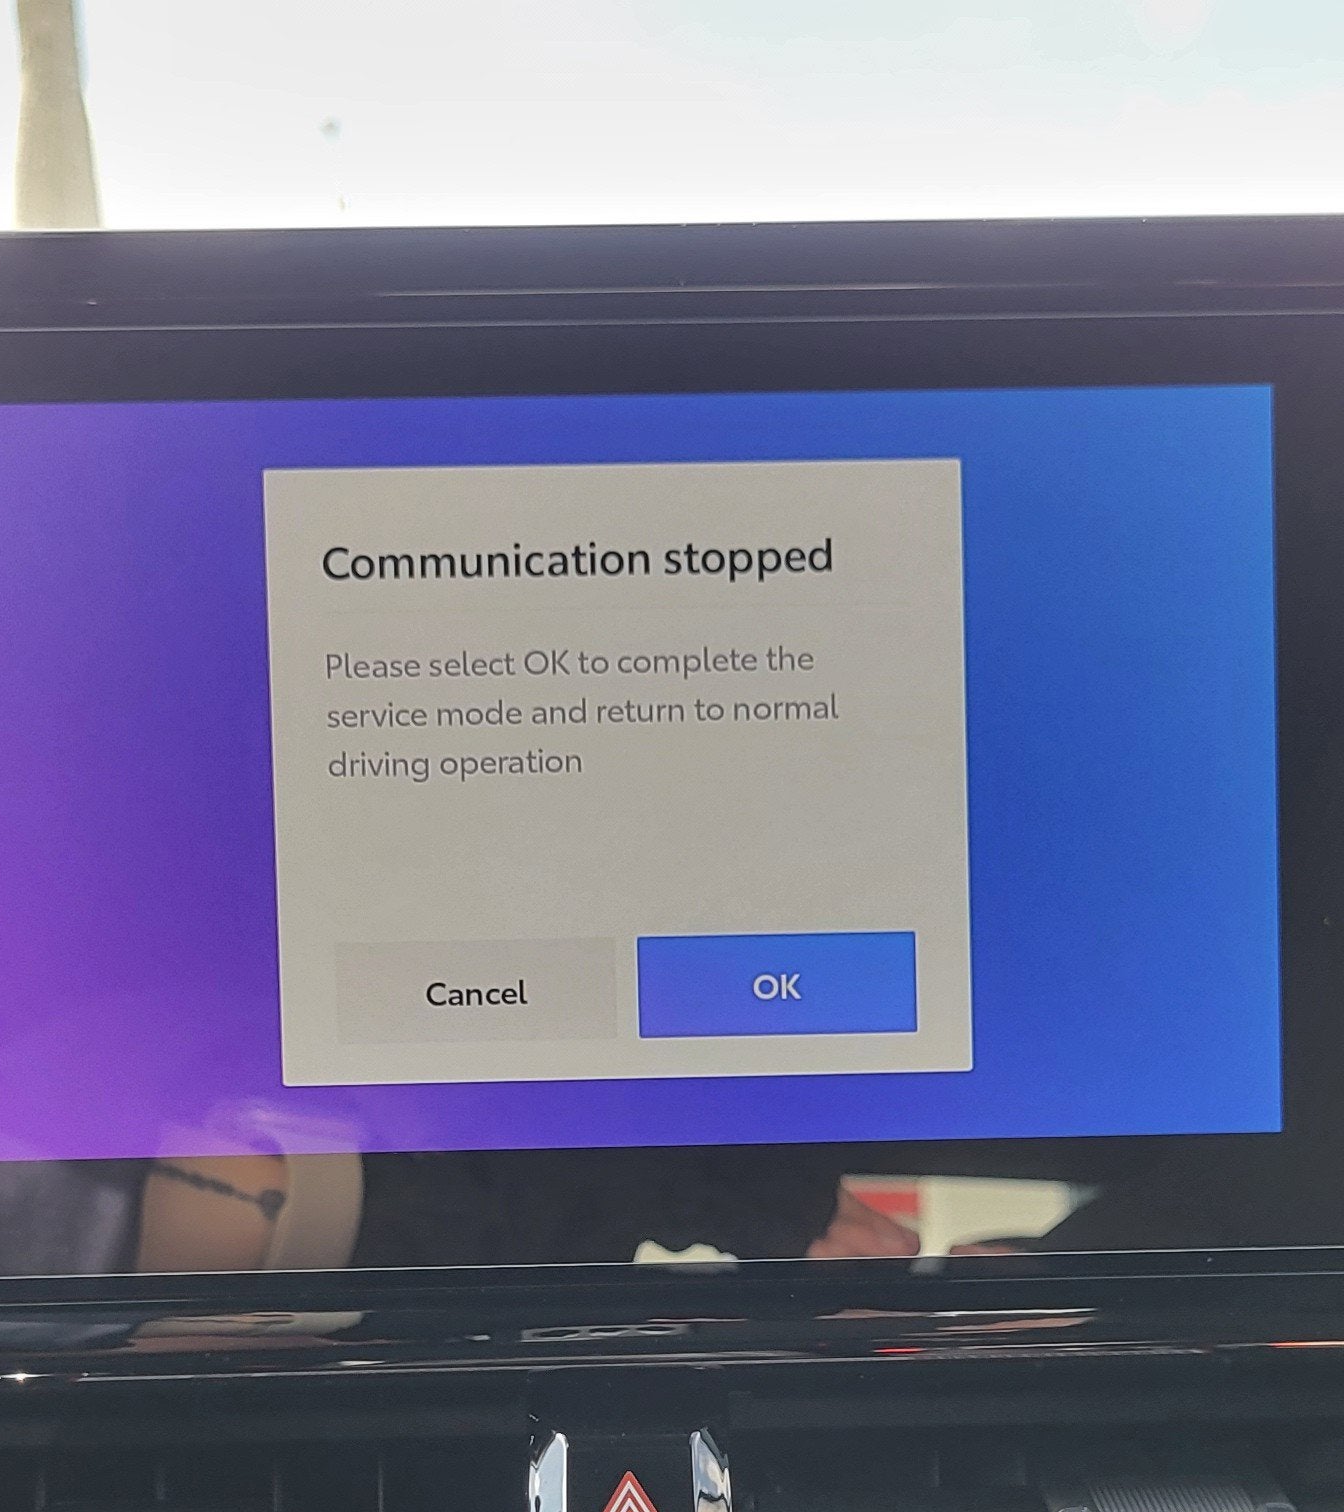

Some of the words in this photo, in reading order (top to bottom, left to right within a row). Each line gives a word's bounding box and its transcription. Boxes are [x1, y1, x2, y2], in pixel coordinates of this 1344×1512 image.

[321, 543, 651, 581] Communication
[663, 538, 833, 583] stopped
[326, 653, 421, 679] Please
[429, 650, 515, 677] select
[523, 649, 571, 676] OK
[578, 652, 610, 675] to
[617, 647, 758, 679] complete
[766, 645, 815, 672] the
[326, 703, 428, 729] service
[436, 700, 522, 726] mode
[531, 698, 587, 725] and
[596, 698, 685, 723] return
[693, 697, 724, 722] to
[733, 693, 839, 721] normal
[328, 751, 430, 783] driving
[439, 749, 583, 783] operation
[425, 979, 529, 1007] Cancel
[753, 973, 802, 1001] OK
